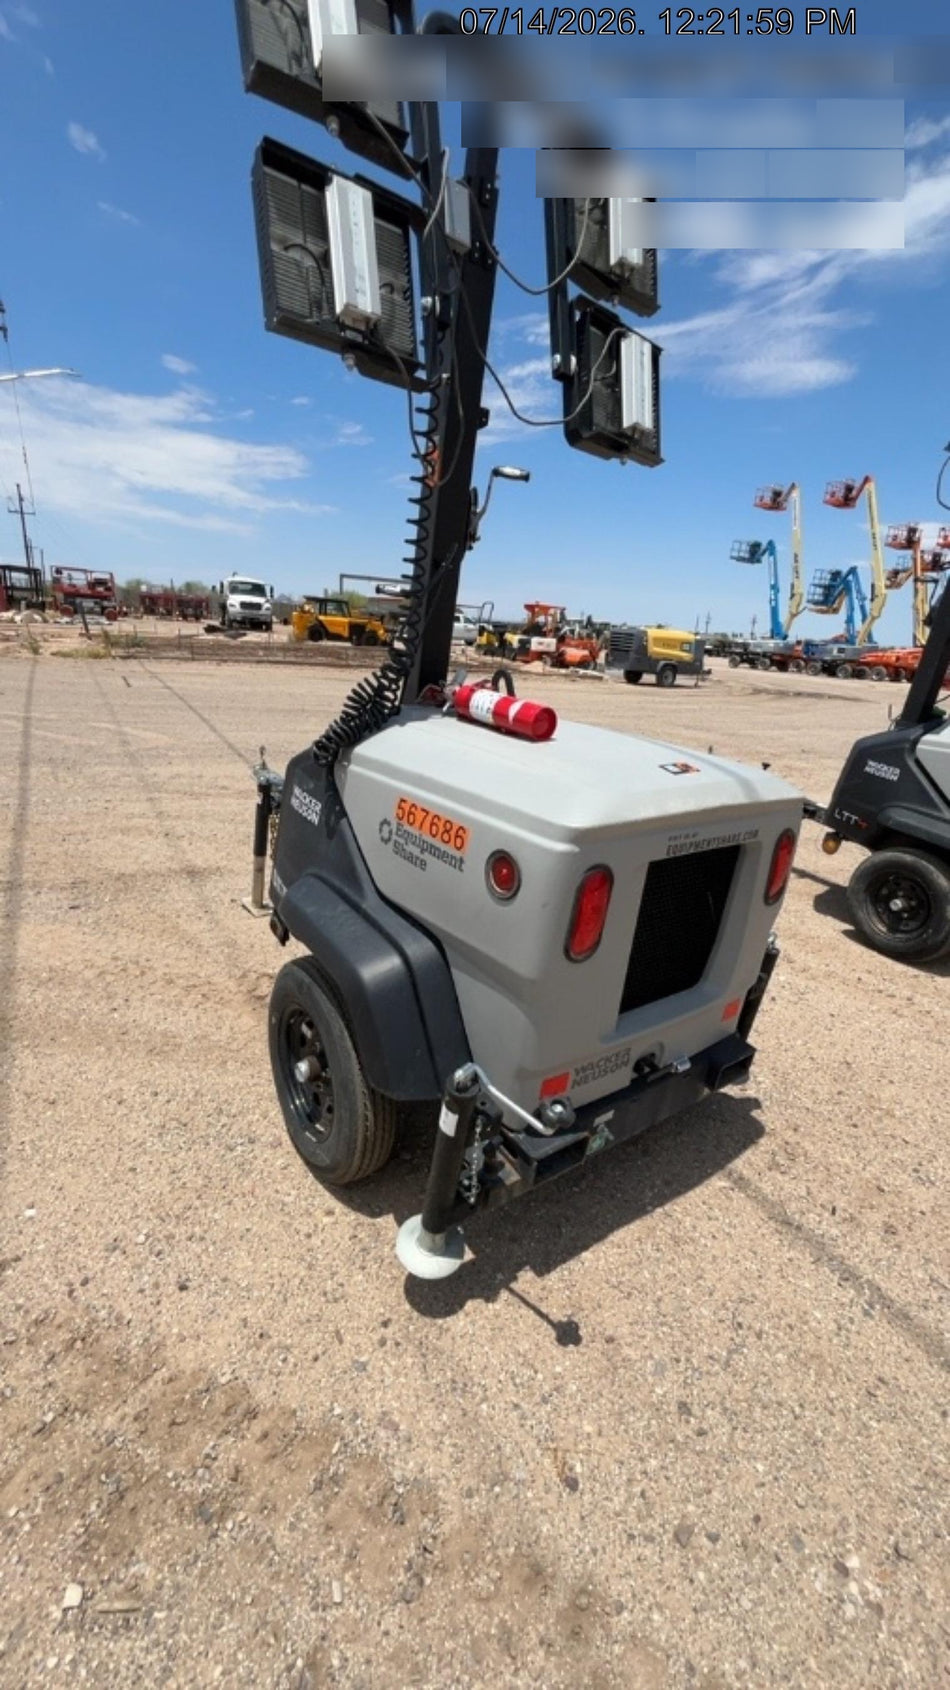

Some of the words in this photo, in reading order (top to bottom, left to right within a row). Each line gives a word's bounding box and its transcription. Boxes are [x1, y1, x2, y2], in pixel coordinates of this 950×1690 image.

[396, 798, 467, 851] 567686
[392, 839, 428, 872] Share
[395, 822, 465, 873] Equipment
[571, 1055, 630, 1090] NEUSON
[574, 1048, 632, 1078] WACKER
